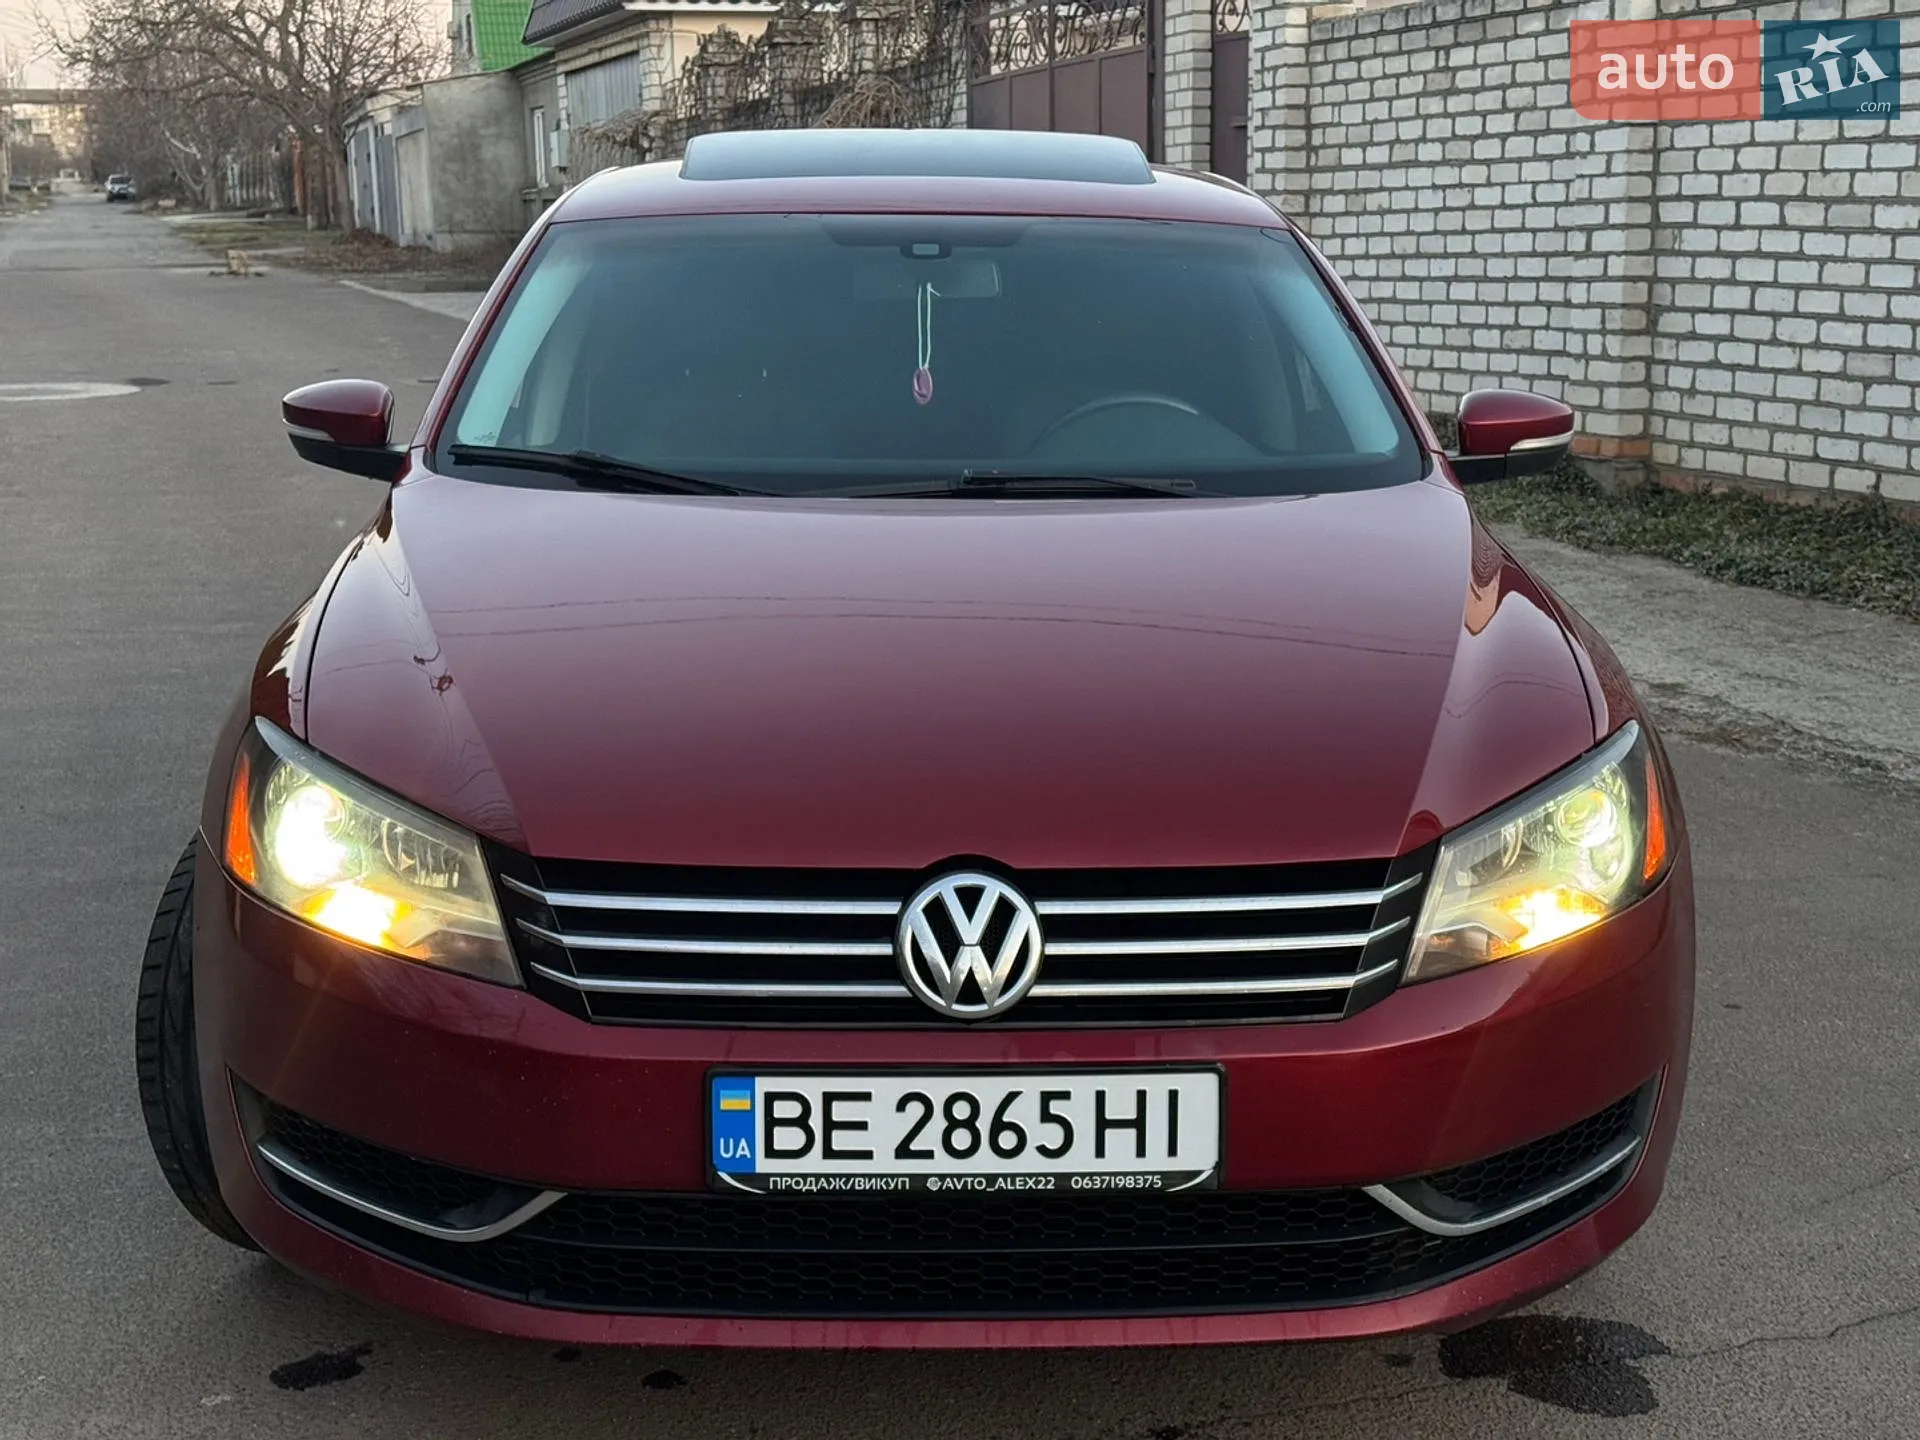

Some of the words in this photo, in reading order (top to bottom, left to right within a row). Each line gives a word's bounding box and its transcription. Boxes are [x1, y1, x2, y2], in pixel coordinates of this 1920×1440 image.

[764, 1091, 874, 1160] BE
[895, 1090, 1075, 1160] 2865
[1095, 1089, 1179, 1158] HI
[720, 1138, 751, 1158] UA
[769, 1176, 910, 1191] ПРОДАЖ/ВИКУП
[1071, 1175, 1162, 1189] 0637198375
